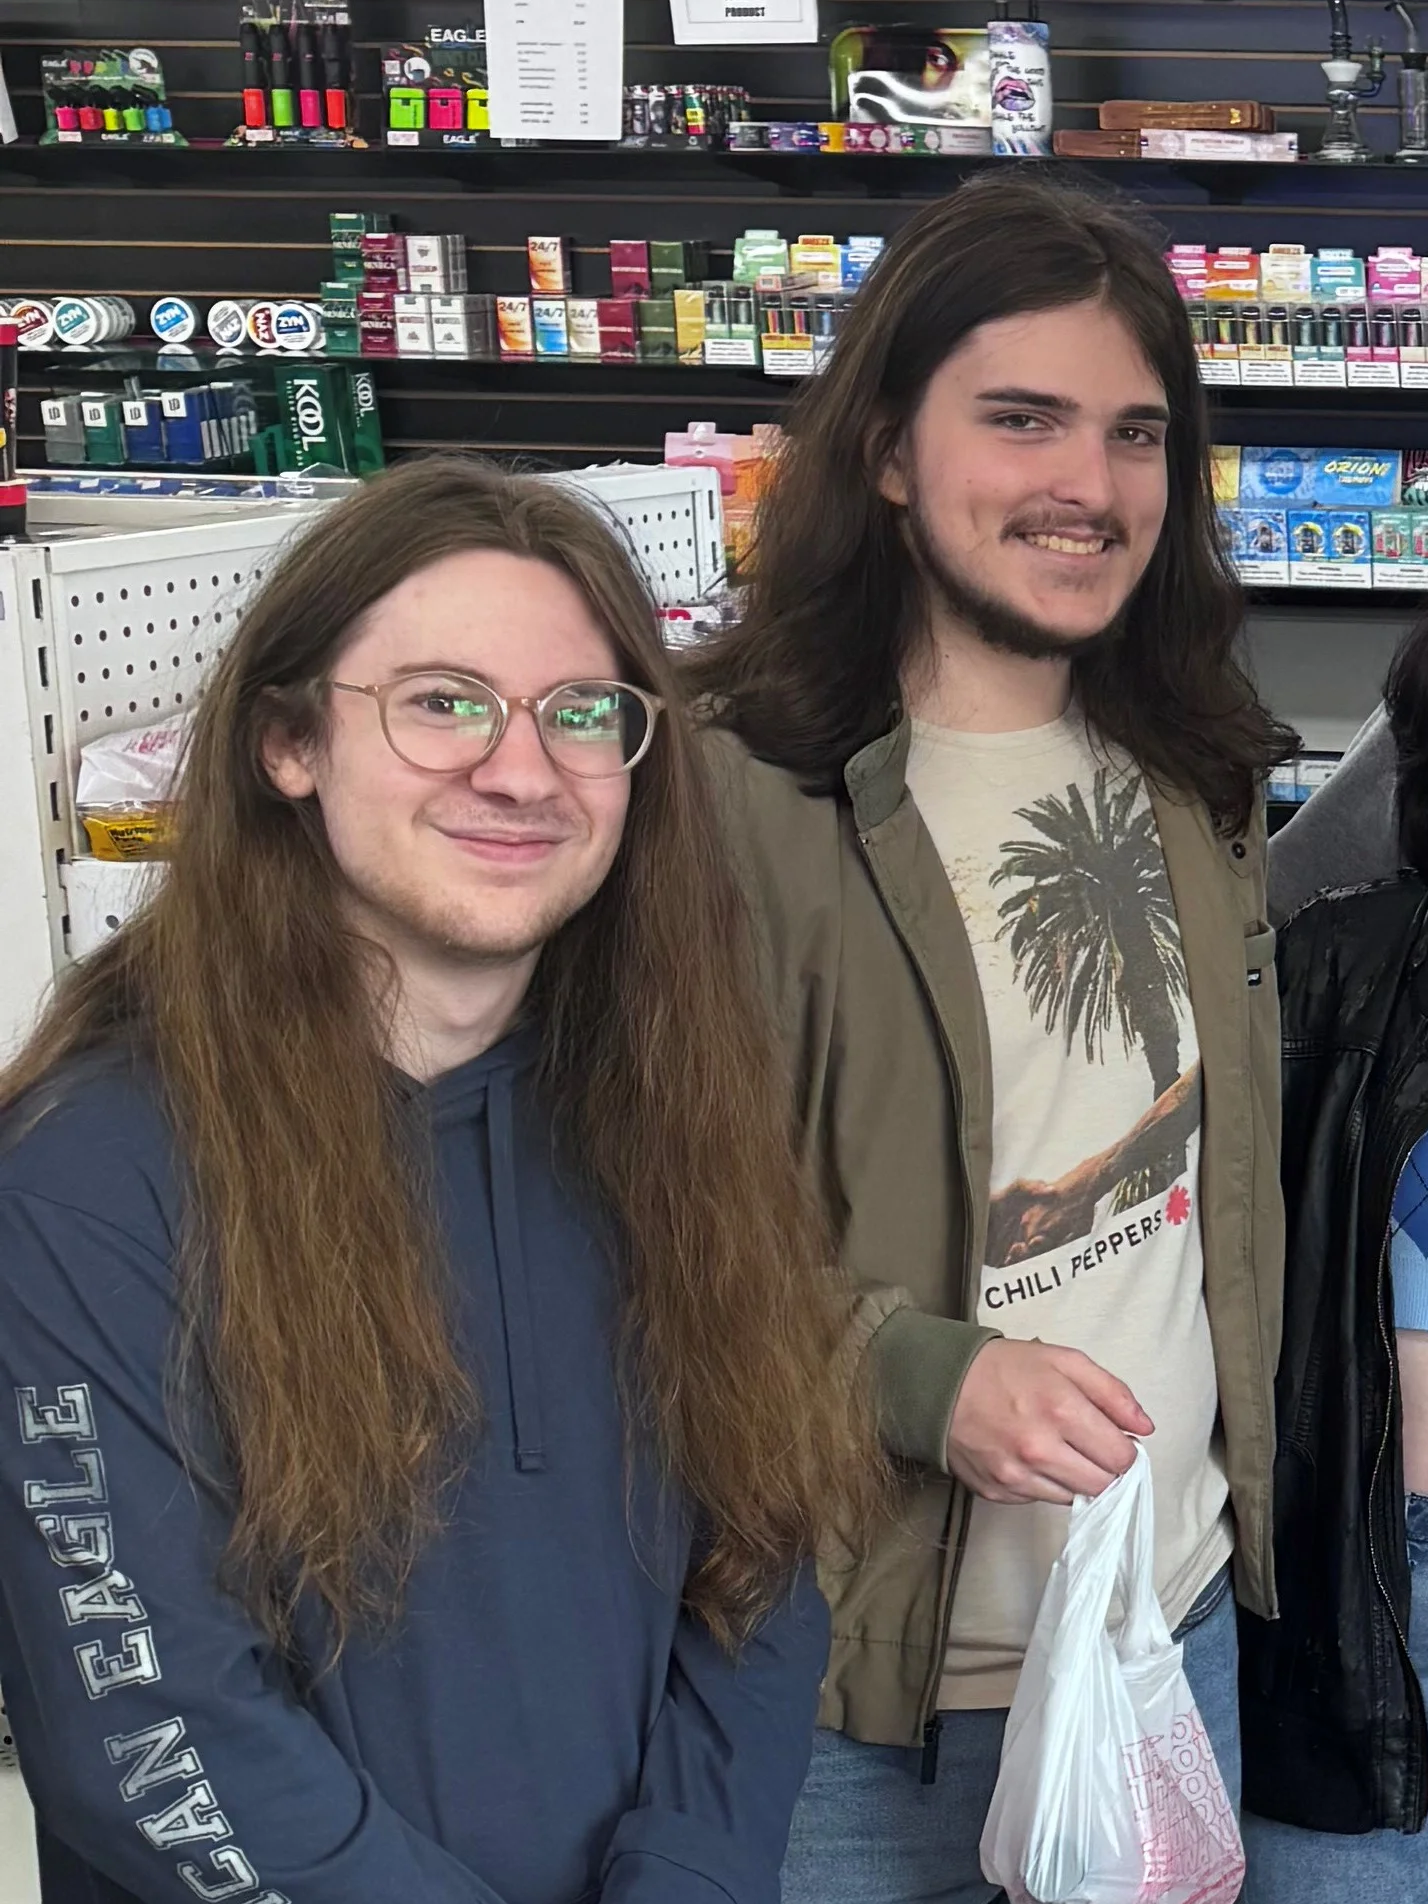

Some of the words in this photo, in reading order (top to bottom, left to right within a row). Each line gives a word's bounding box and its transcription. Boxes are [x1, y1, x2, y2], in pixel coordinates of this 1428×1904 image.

[725, 7, 765, 17] PRODUCT
[531, 241, 559, 252] 24/7
[499, 301, 527, 312] 24/7
[535, 307, 564, 318] 24/7
[570, 308, 597, 319] 24/7
[58, 306, 83, 327] ZYN
[155, 305, 181, 326] ZYN
[277, 316, 304, 327] ZYN
[355, 372, 375, 418] KOOL
[293, 379, 327, 452] KOOL
[984, 1266, 1062, 1310] CHILI
[1071, 1209, 1163, 1278] PEPPERS
[15, 1382, 162, 1701] EAGLE
